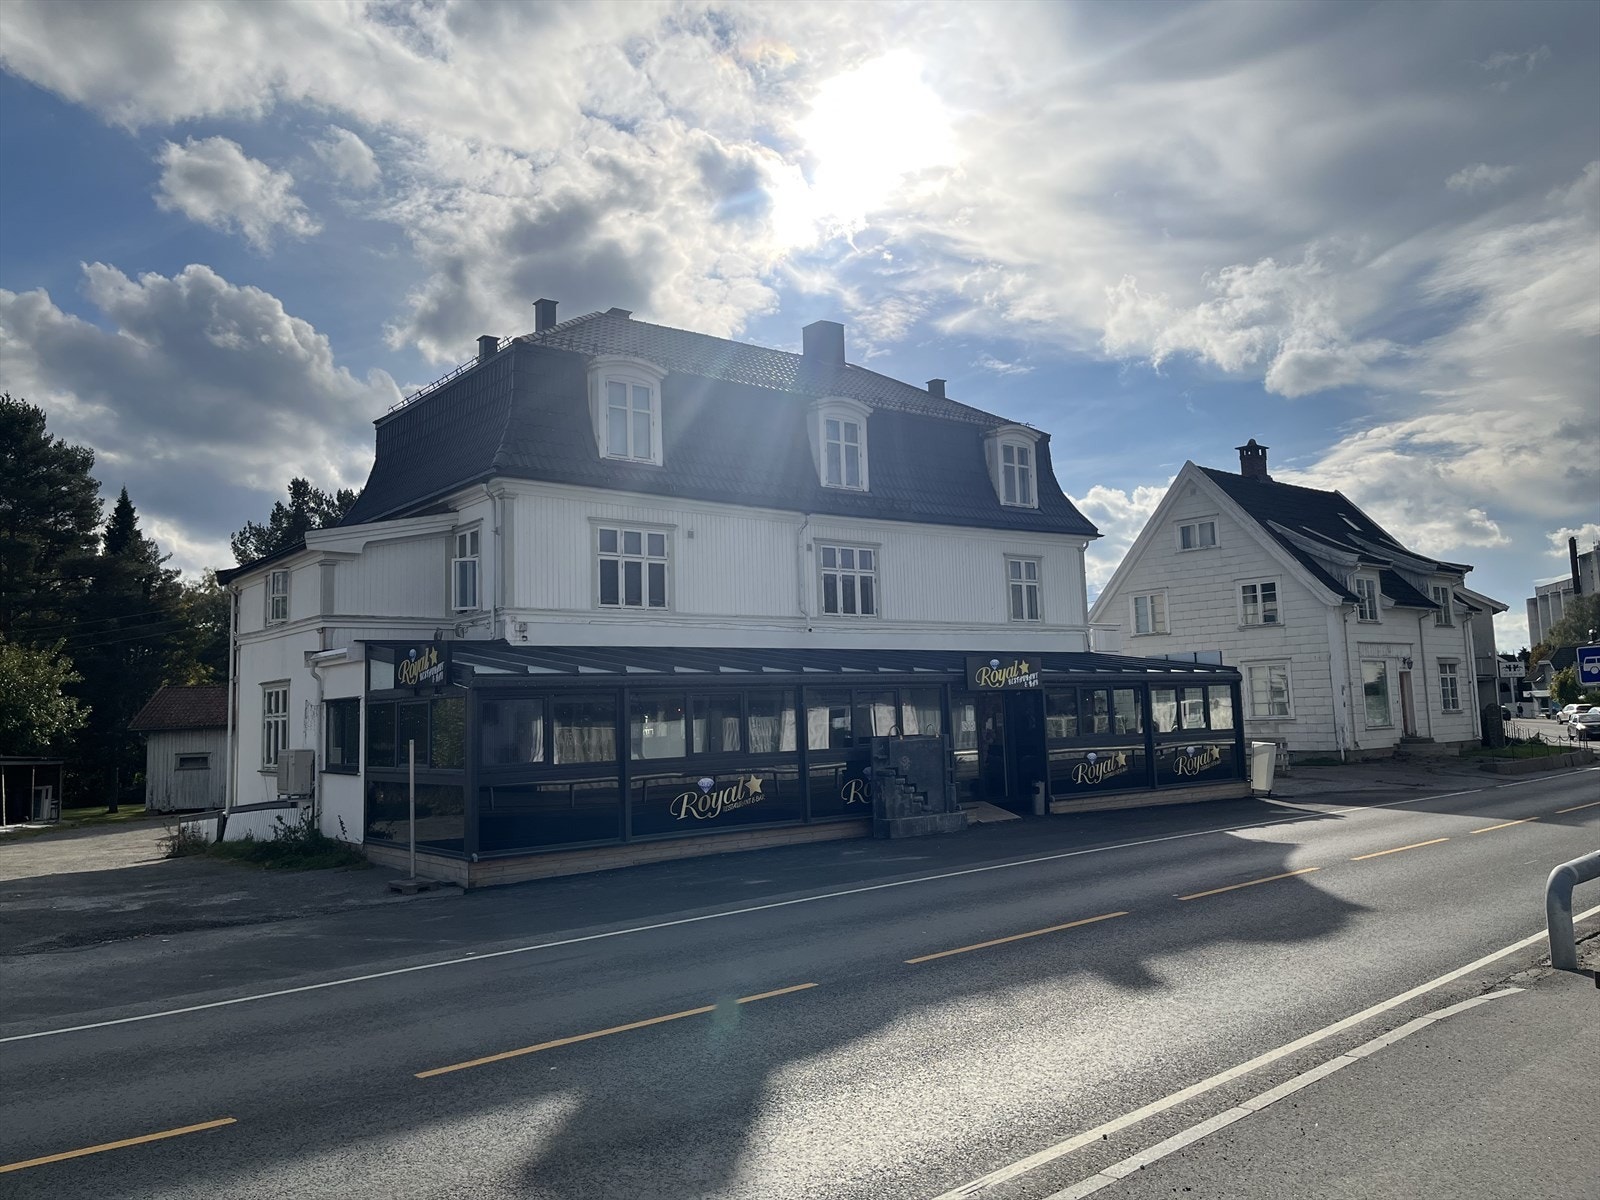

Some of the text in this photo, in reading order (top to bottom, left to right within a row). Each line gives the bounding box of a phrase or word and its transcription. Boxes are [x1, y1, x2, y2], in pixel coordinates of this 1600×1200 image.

[398, 647, 430, 685] Royal
[975, 660, 1019, 688] Royal
[1071, 752, 1117, 785] Royal
[1173, 748, 1211, 776] Royal
[669, 776, 746, 820] Royal
